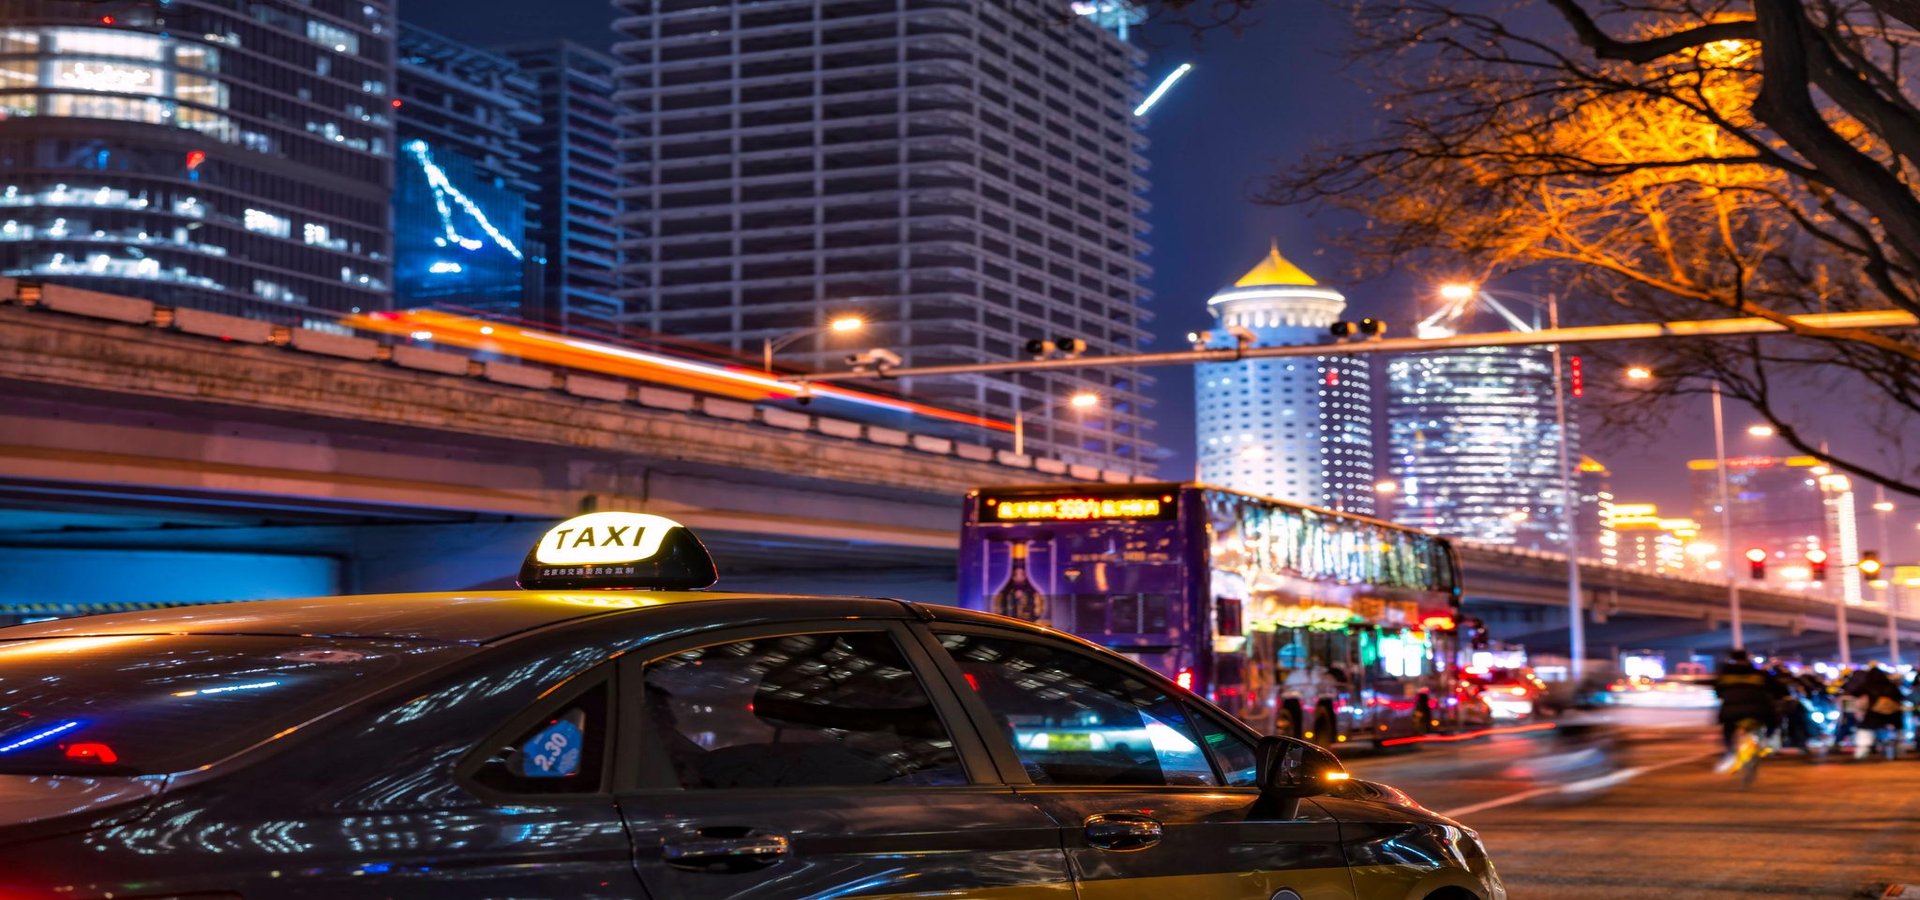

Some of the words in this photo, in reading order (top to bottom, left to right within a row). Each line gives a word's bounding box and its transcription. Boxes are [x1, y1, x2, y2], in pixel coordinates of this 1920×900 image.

[556, 526, 646, 549] TAXI
[543, 567, 635, 576] 北京市交通委员会监制
[534, 733, 567, 771] 2.30
